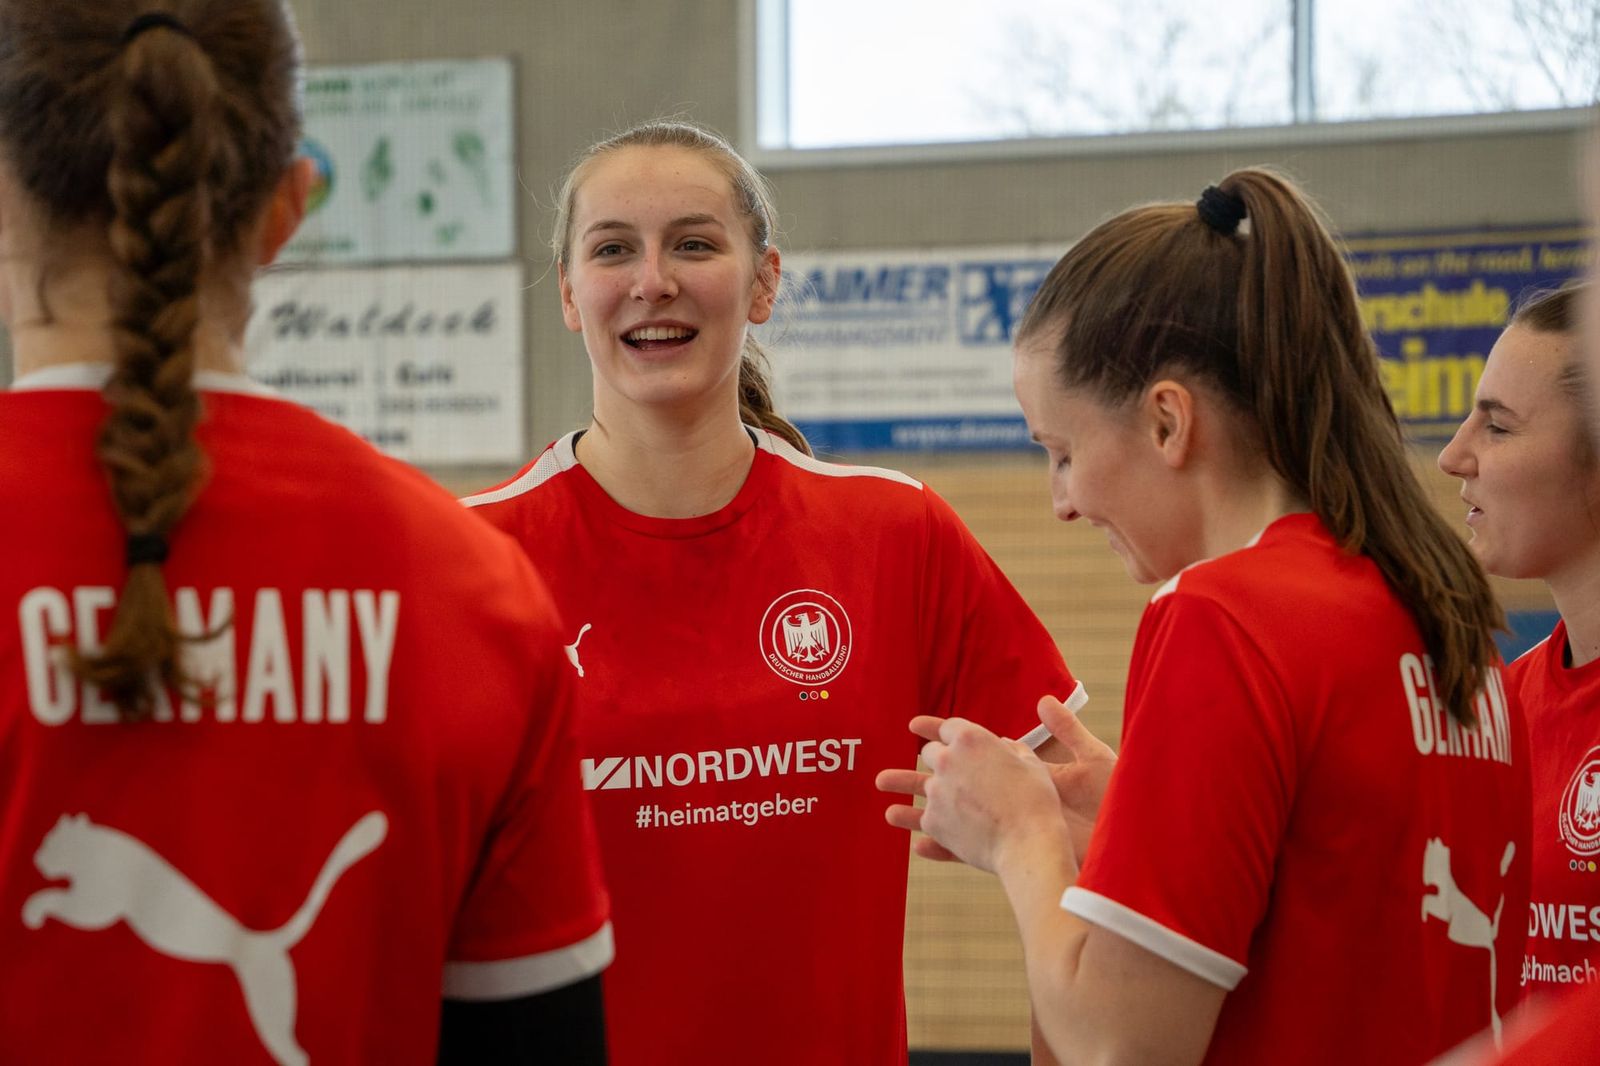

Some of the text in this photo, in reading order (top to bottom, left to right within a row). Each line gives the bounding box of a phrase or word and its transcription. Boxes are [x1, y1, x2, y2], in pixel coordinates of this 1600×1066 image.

[768, 645, 847, 680] DEUTSCHER HANDBALLBUND
[635, 738, 862, 789] NORDWEST
[636, 793, 818, 828] #heimatgeber
